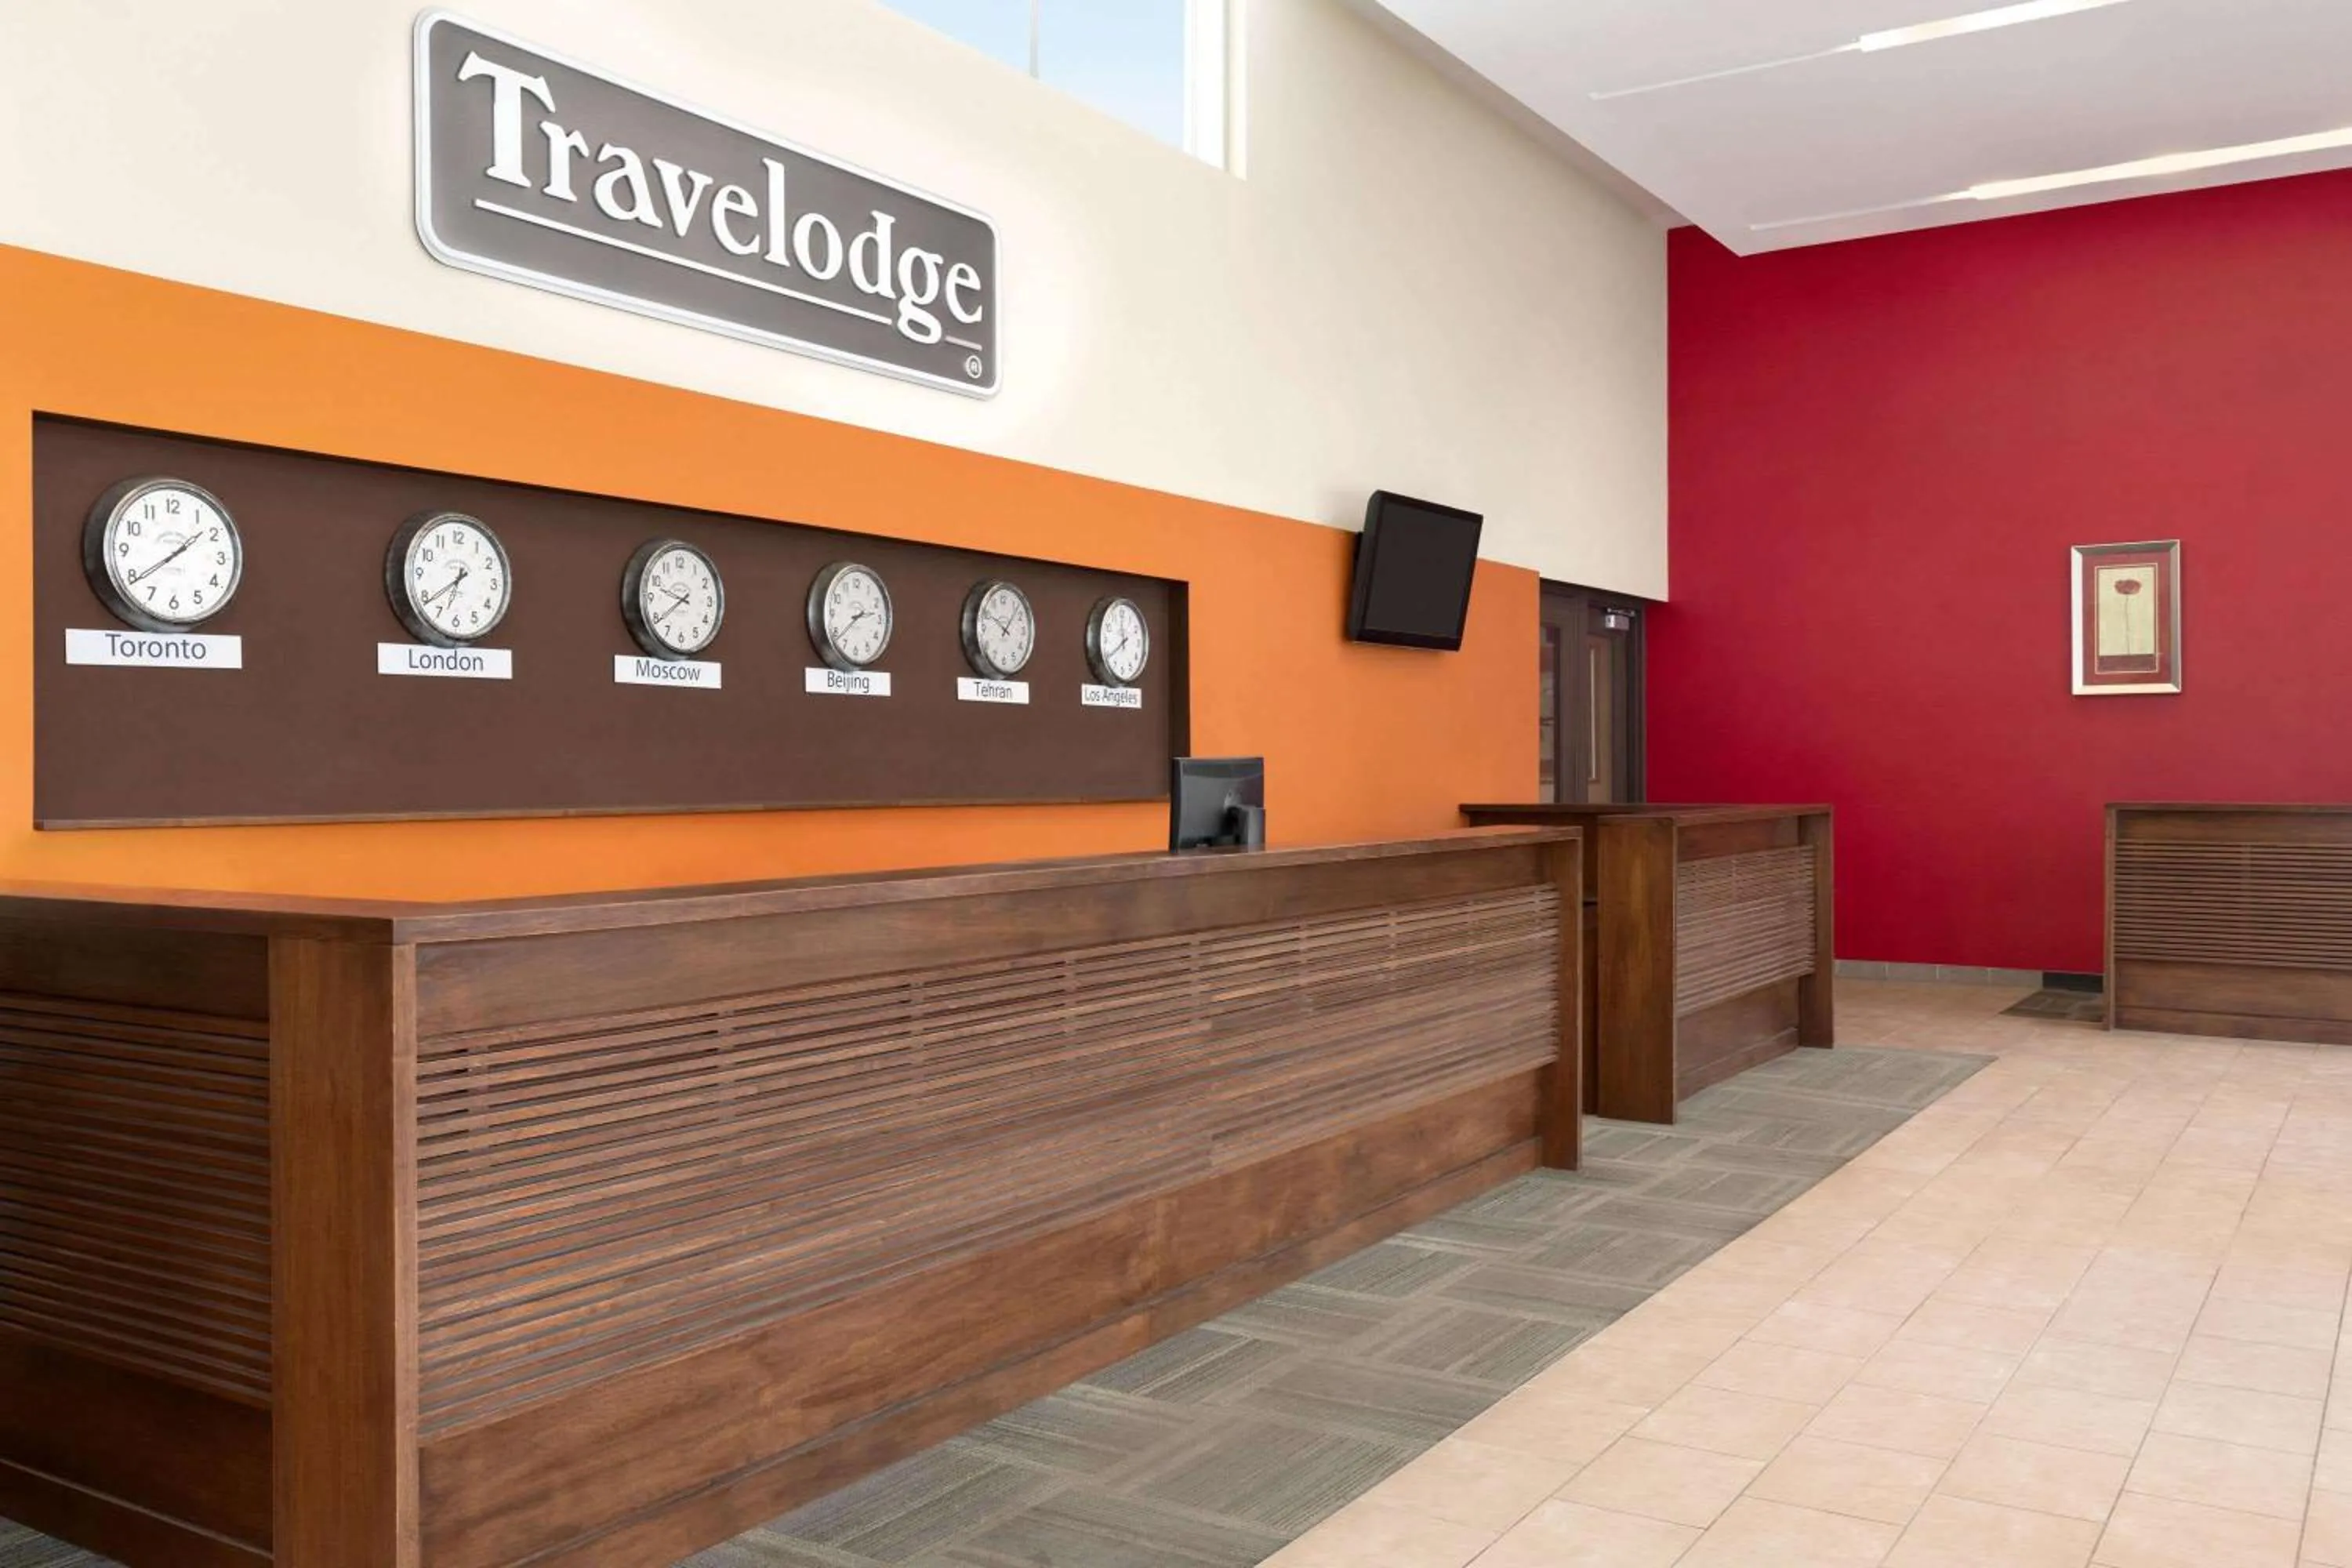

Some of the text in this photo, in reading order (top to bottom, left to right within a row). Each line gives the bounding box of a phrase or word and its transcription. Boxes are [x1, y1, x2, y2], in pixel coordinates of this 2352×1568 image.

[458, 51, 982, 343] Travelodge
[143, 505, 155, 520] 11
[166, 499, 180, 514] 12
[196, 510, 199, 524] 1
[127, 521, 140, 536] 10
[210, 528, 219, 542] 2
[436, 535, 444, 549] 11
[453, 531, 464, 544] 12
[119, 543, 129, 557] 9
[475, 542, 478, 554] 1
[217, 552, 225, 565] 3
[423, 549, 433, 561] 10
[485, 557, 492, 569] 2
[663, 562, 670, 574] 11
[675, 557, 684, 568] 12
[129, 569, 136, 585] 8
[416, 567, 423, 579] 9
[210, 574, 219, 587] 4
[490, 579, 497, 590] 3
[652, 575, 660, 586] 10
[702, 578, 708, 589] 2
[147, 586, 156, 601] 7
[194, 591, 202, 604] 5
[422, 590, 428, 604] 8
[648, 593, 654, 604] 9
[169, 596, 179, 610] 6
[484, 598, 491, 609] 4
[707, 597, 712, 608] 3
[436, 606, 442, 618] 7
[471, 612, 477, 623] 5
[654, 612, 659, 624] 8
[702, 614, 708, 623] 4
[452, 615, 459, 627] 6
[665, 626, 670, 637] 7
[678, 632, 684, 643] 6
[693, 627, 699, 638] 5
[105, 633, 206, 659] Toronto
[408, 648, 484, 671] London
[636, 659, 701, 681] Moscow
[828, 671, 869, 693] Beijing
[974, 682, 1012, 699] Tehran
[1085, 687, 1138, 706] Los Angeles
